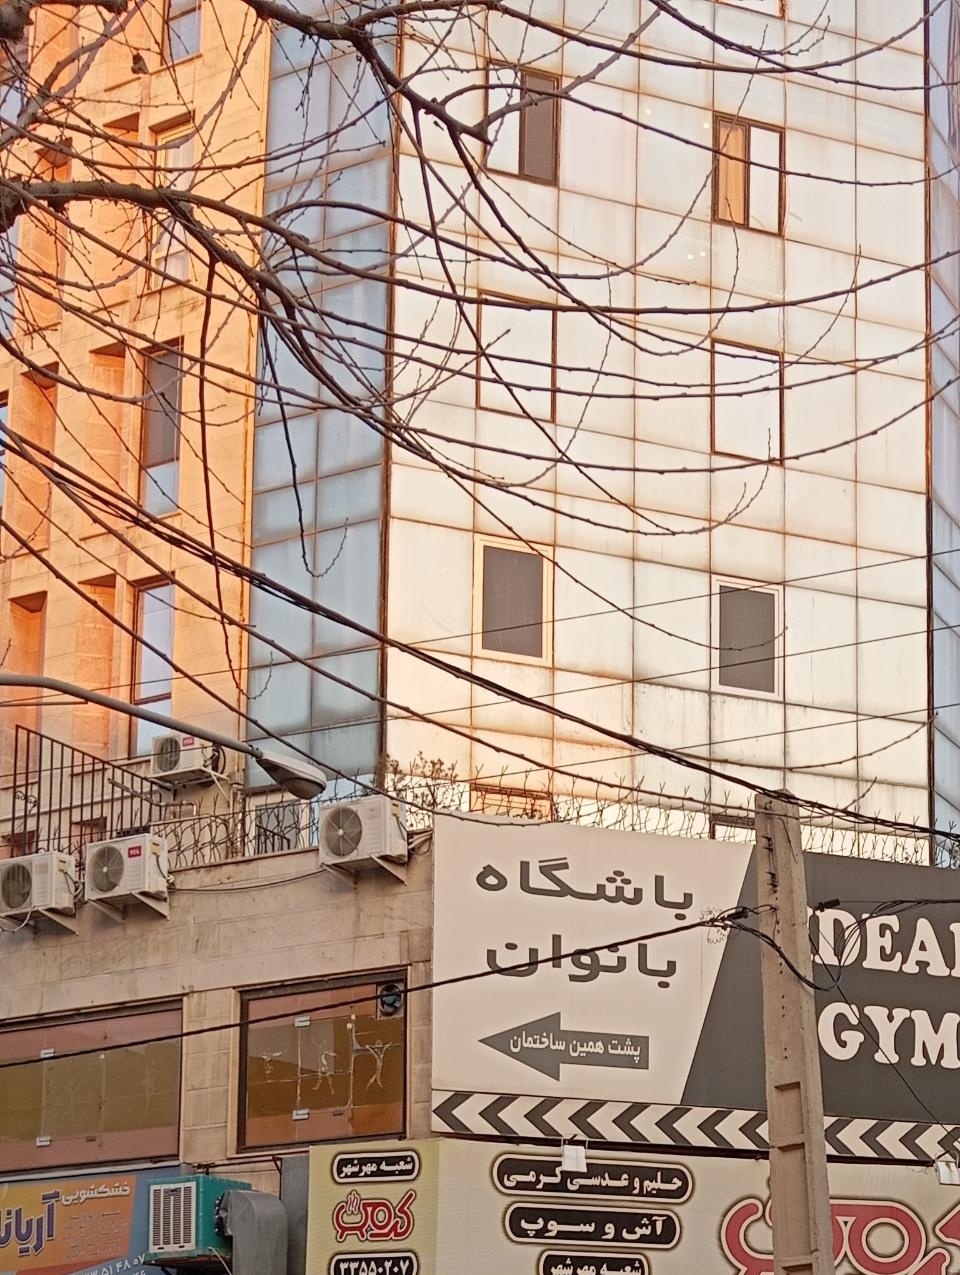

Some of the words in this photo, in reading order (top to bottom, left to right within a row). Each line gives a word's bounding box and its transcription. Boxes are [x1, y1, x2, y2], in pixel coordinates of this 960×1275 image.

[476, 857, 694, 921] باشگاه
[486, 934, 677, 989] بانوان
[510, 1031, 566, 1053] ساختمان
[569, 1038, 605, 1057] همین
[608, 1038, 641, 1064] پشت
[380, 1157, 413, 1174] شعبه
[503, 1165, 563, 1190] کرمی
[566, 1172, 629, 1191] عدسی
[632, 1178, 640, 1194] و
[643, 1171, 682, 1195] حلیم
[61, 1182, 131, 1205] خشکشویی
[0, 1189, 61, 1257] آریان
[520, 1217, 595, 1237] سوپ
[601, 1222, 616, 1239] و
[622, 1216, 667, 1240] آش
